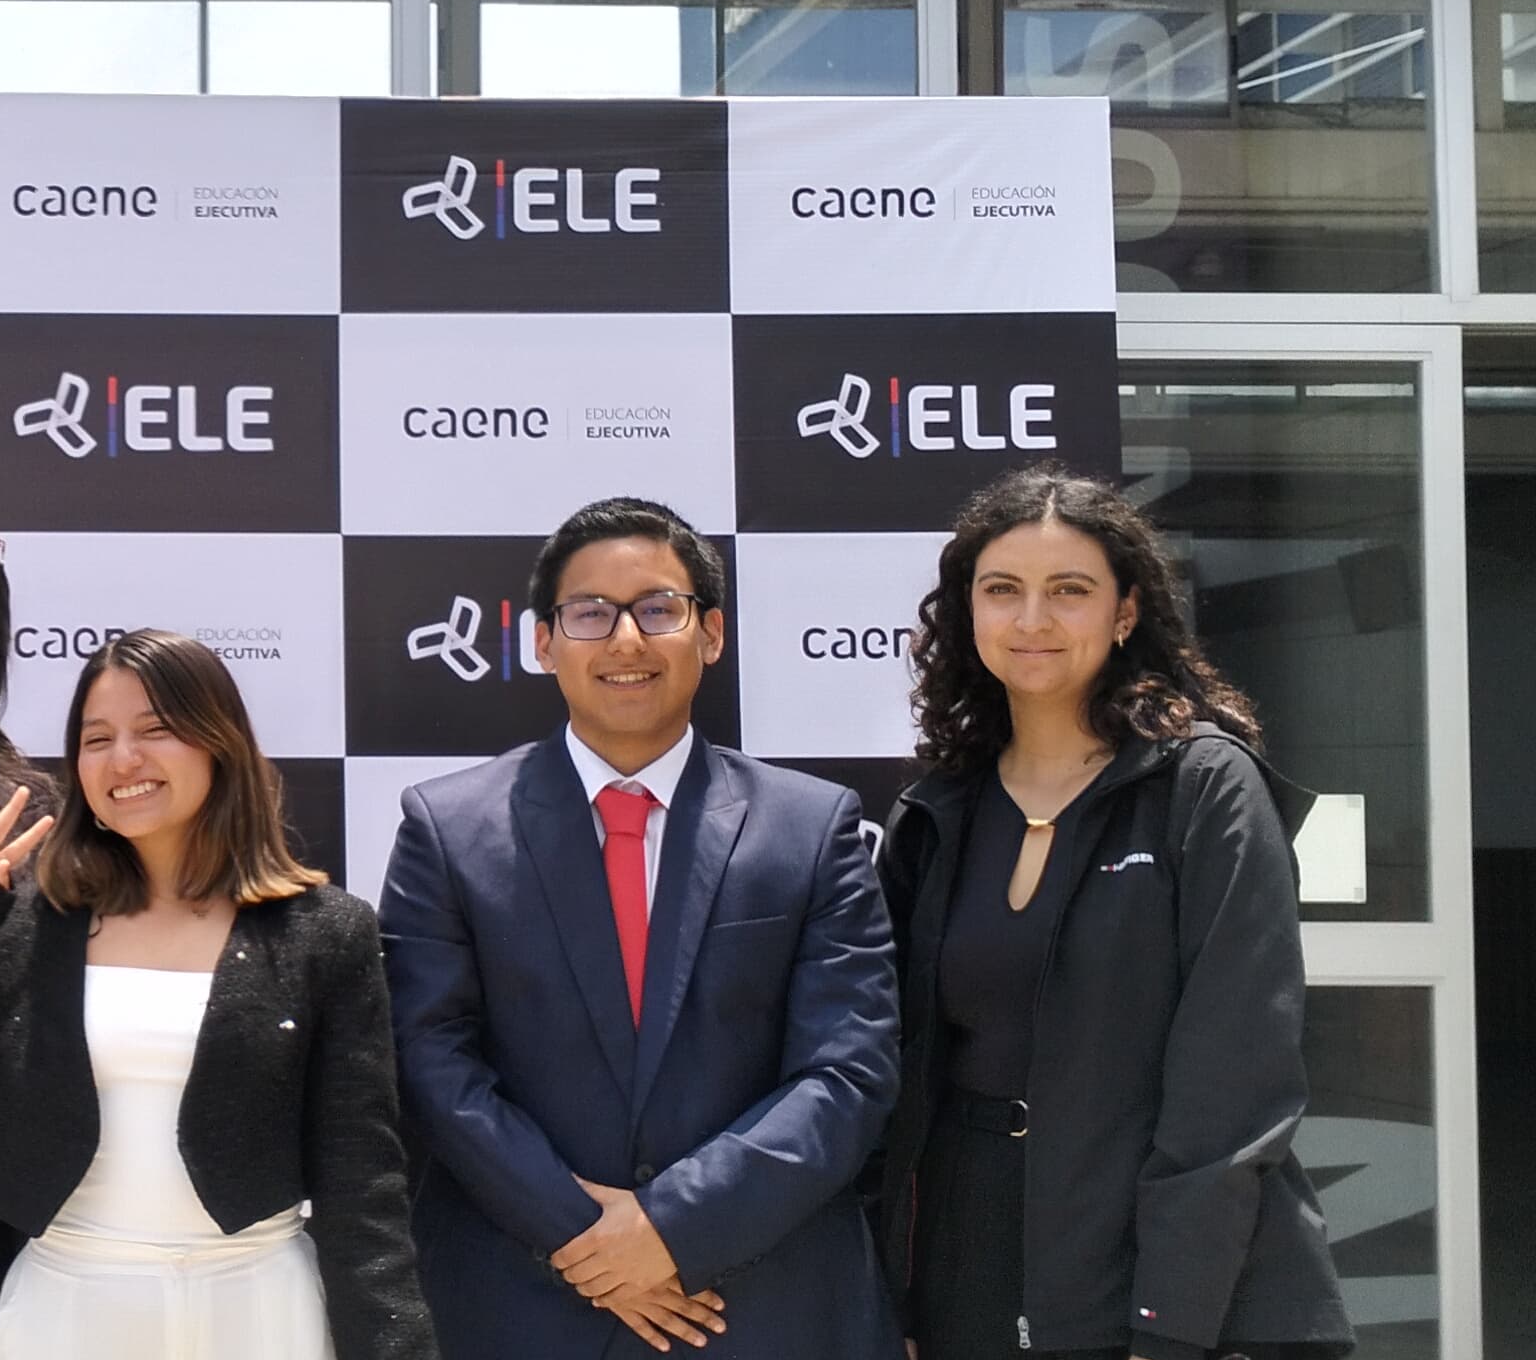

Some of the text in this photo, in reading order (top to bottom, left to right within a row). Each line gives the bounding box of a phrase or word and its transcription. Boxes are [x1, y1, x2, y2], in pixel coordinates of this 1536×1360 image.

[13, 184, 158, 218] caene
[193, 185, 279, 201] EDUCACIÓN
[513, 167, 661, 233] ELE
[791, 186, 936, 218] caene
[971, 184, 1056, 200] EDUCACIÓN
[194, 205, 278, 219] EJECUTIVA
[972, 204, 1056, 218] EJECUTIVA
[124, 385, 274, 452] ELE
[403, 406, 549, 439] caene
[585, 405, 671, 421] EDUCACIÓN
[908, 384, 1057, 450] ELE
[586, 426, 671, 440] EJECUTIVA
[14, 627, 126, 658] cae
[195, 626, 281, 641] EDUCACIÓN
[802, 627, 914, 659] caen
[209, 647, 281, 659] ECUTIVA
